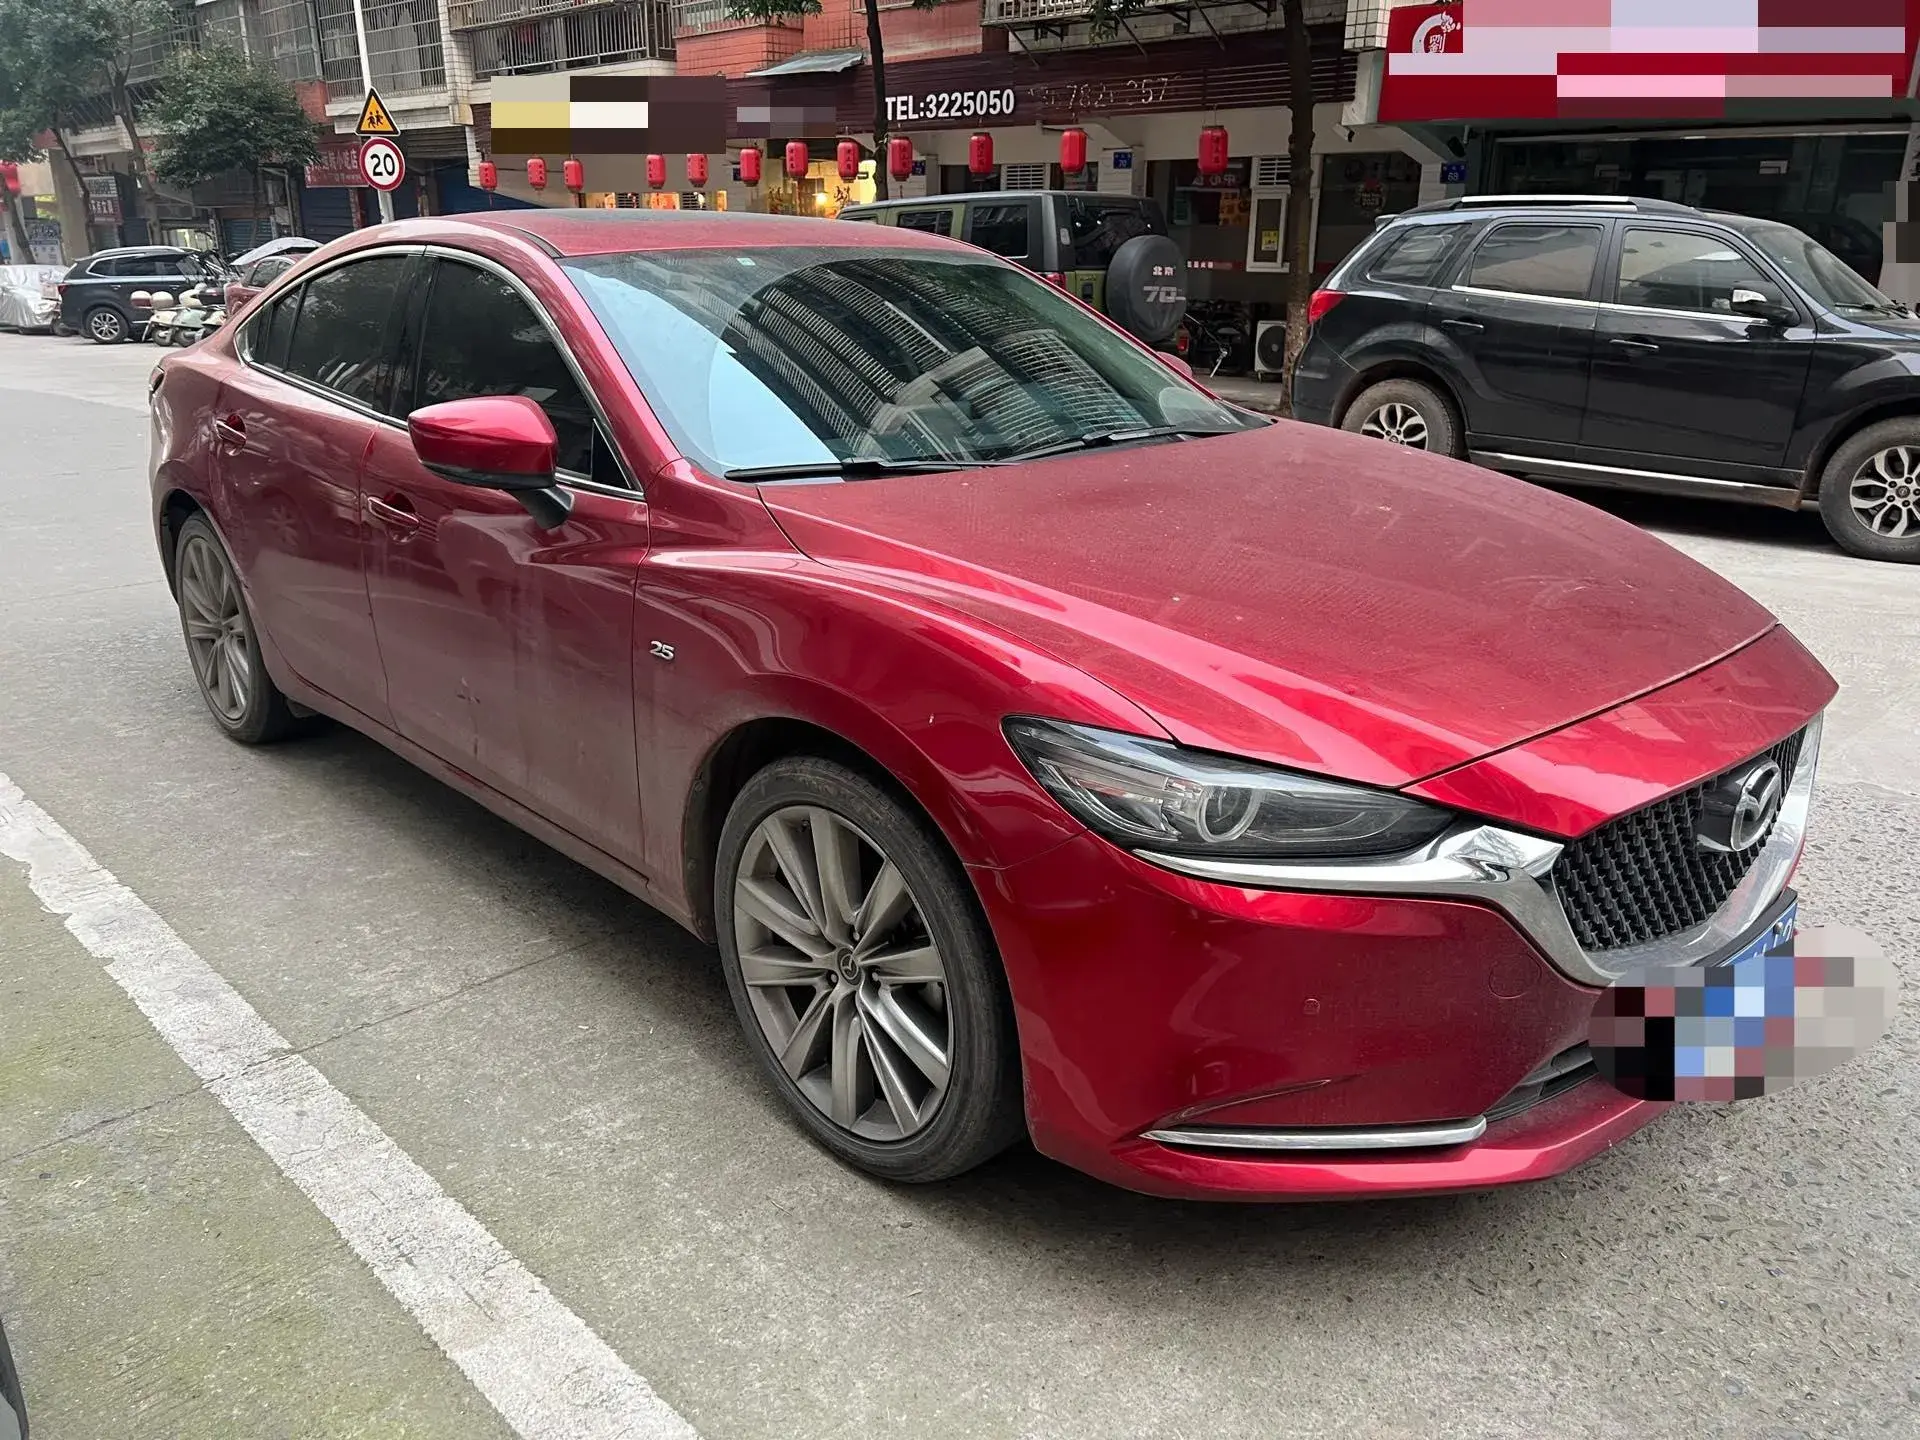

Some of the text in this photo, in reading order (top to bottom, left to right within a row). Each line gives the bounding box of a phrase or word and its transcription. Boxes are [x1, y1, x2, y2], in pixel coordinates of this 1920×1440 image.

[885, 88, 1015, 121] TEL:3225050
[370, 153, 395, 176] 20
[1153, 266, 1174, 276] 北京
[650, 640, 675, 660] 25
